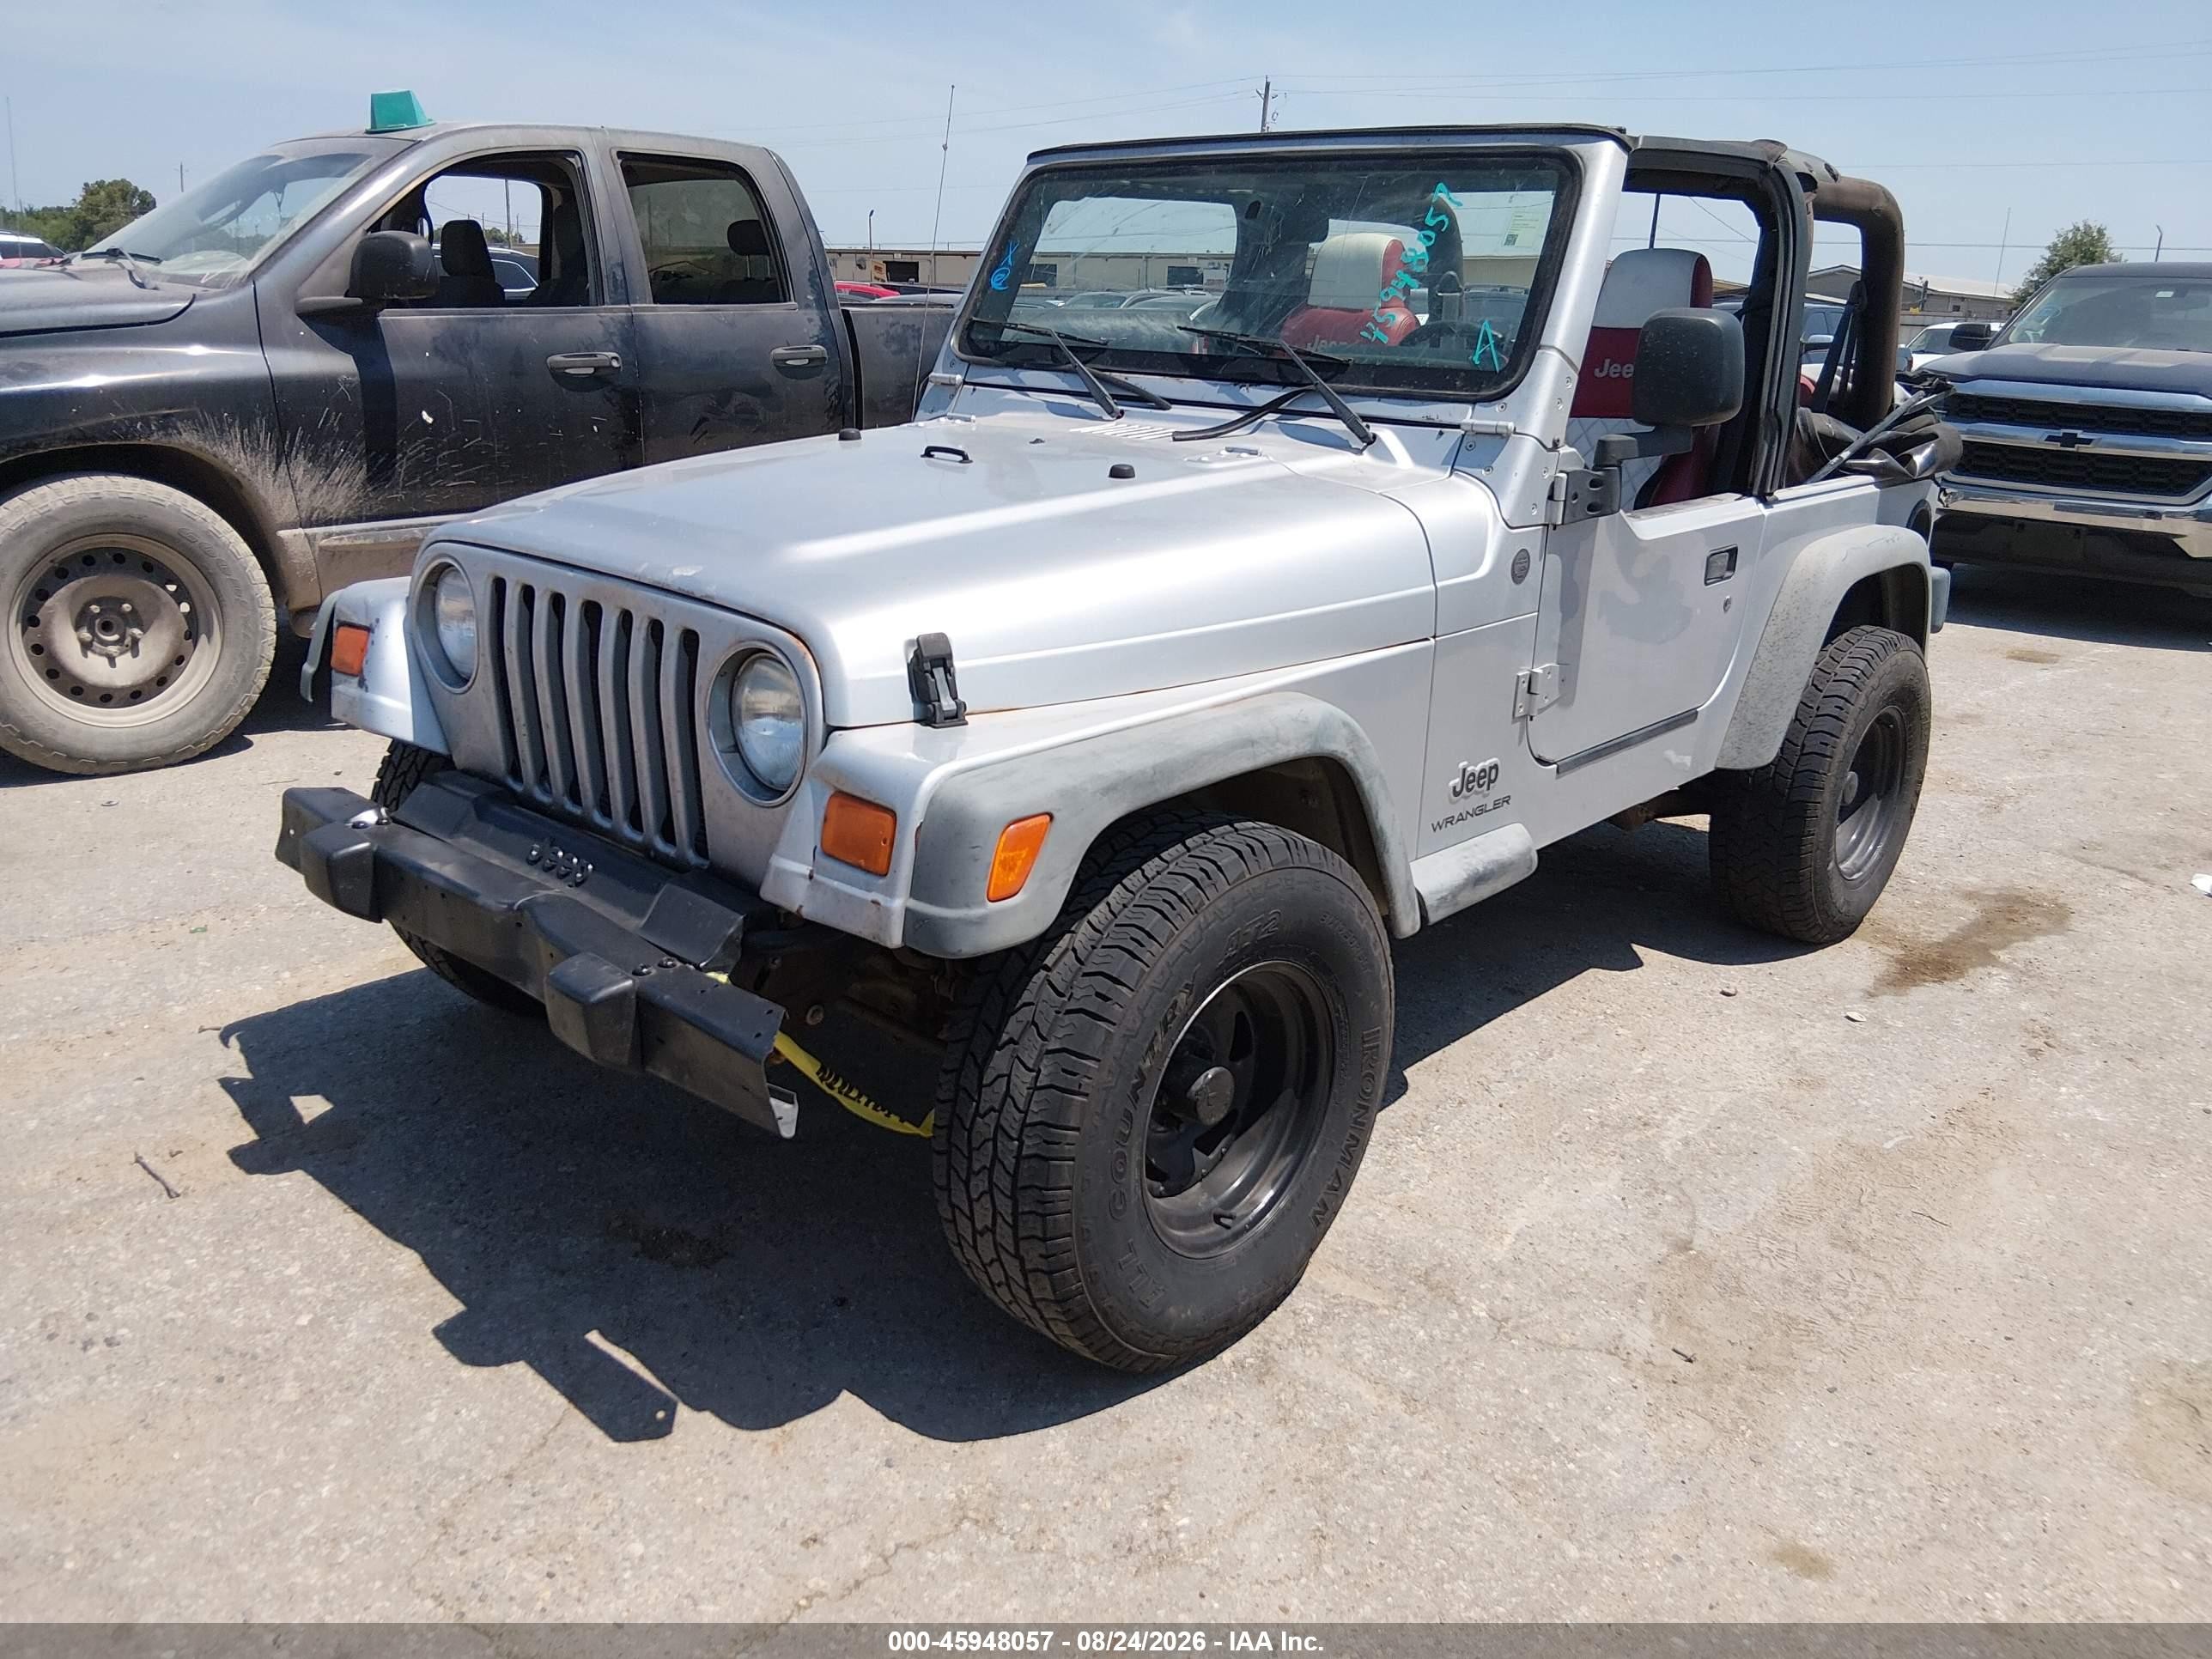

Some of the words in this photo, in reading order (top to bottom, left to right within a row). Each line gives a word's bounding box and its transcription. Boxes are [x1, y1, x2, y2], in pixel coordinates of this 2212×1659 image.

[1472, 319, 1500, 374] A
[1449, 758, 1499, 799] Jeep
[1431, 795, 1511, 833] WRANGLER
[1308, 1025, 1382, 1228] IRONMAN
